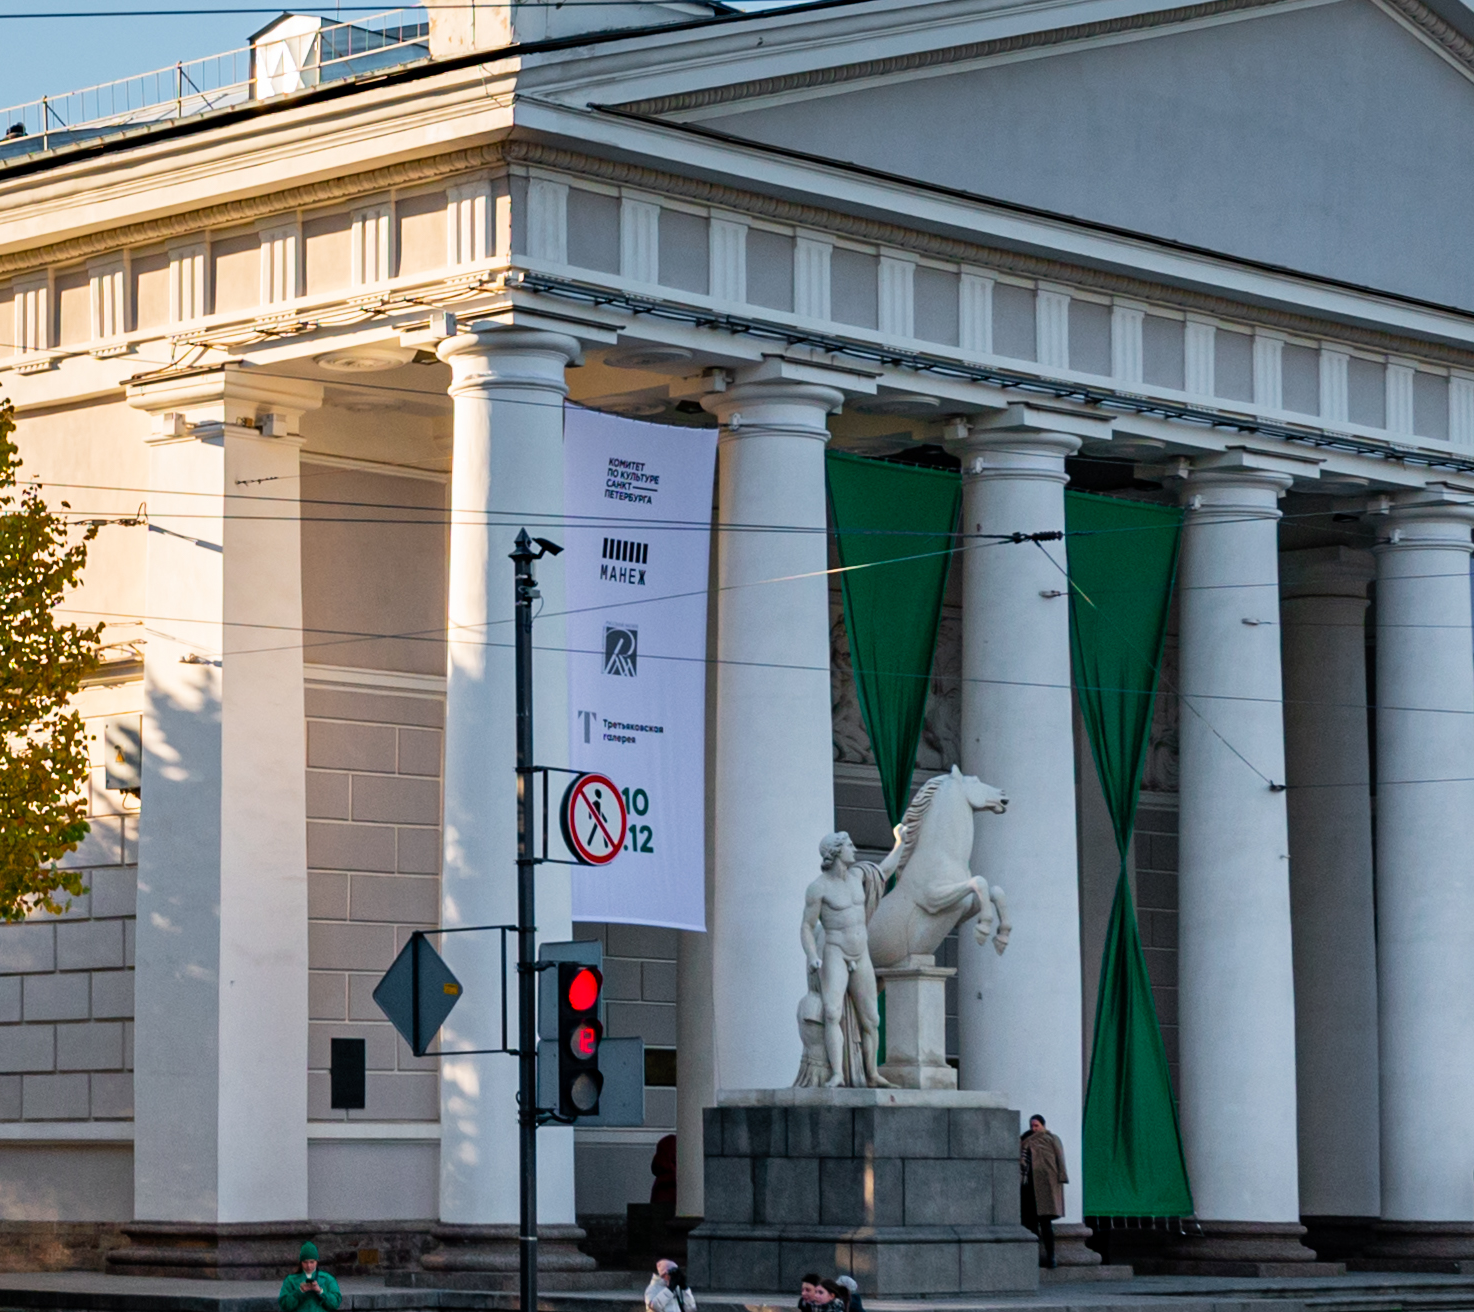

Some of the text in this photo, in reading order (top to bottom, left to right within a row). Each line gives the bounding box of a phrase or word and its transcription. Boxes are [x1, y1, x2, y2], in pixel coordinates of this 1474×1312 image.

[608, 457, 645, 472] КОМИТЕТ
[607, 468, 660, 485] ПО КУЛЬТУРЕ
[604, 489, 652, 504] ПЕТЕРБУРГА
[600, 564, 646, 586] МАНЕЖ
[603, 718, 664, 734] Третьяковская
[603, 733, 636, 745] галерея
[623, 824, 654, 853] .12
